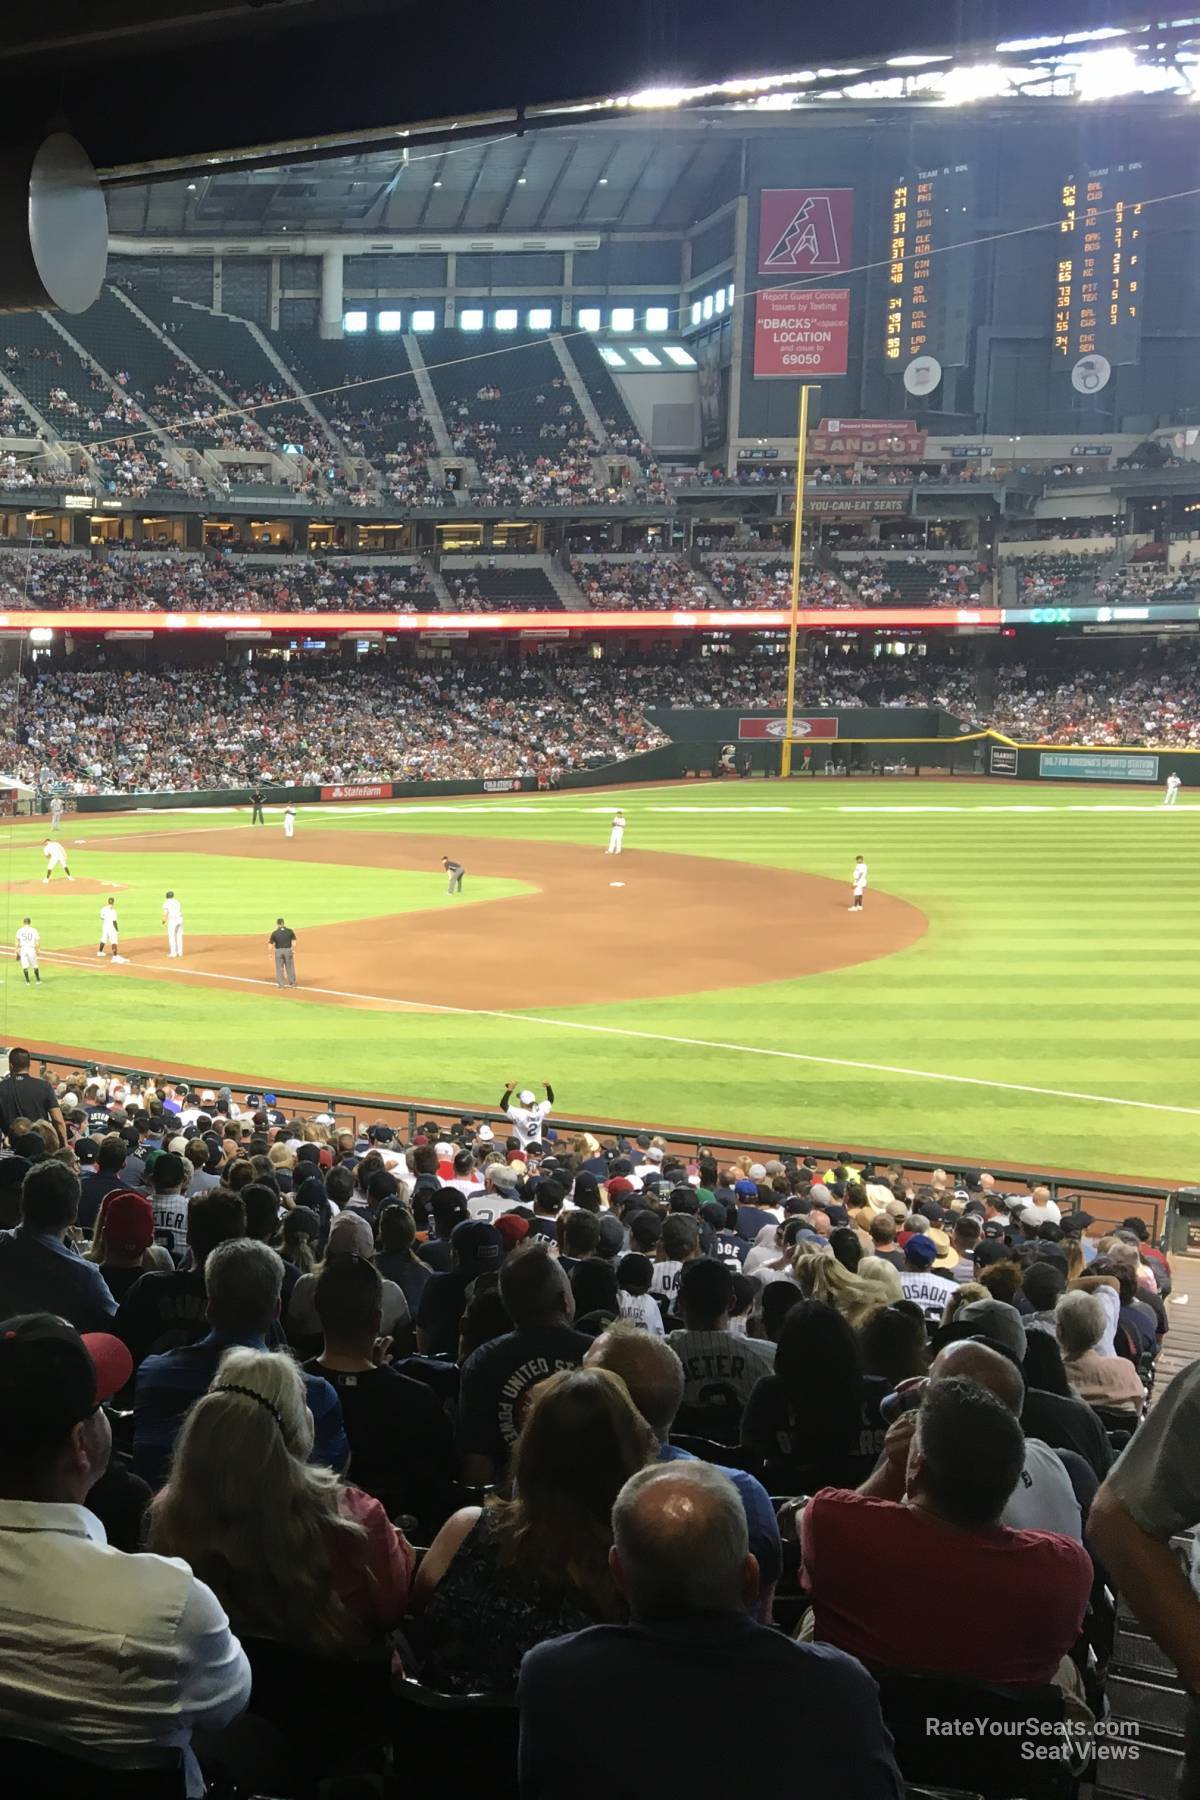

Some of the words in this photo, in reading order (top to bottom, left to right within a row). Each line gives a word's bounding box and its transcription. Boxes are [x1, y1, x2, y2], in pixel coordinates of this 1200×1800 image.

[918, 170, 938, 179] TEAM
[1088, 168, 1108, 177] TEAM
[1063, 185, 1076, 196] 54
[894, 198, 906, 208] 27
[893, 223, 905, 233] 31
[1061, 221, 1074, 232] 57
[916, 234, 931, 244] CLE
[892, 248, 904, 258] 31
[891, 263, 903, 273] 28
[891, 274, 903, 283] 48
[763, 292, 788, 301] Report
[790, 292, 812, 300] Guest
[815, 291, 847, 300] Conduct
[1059, 287, 1071, 296] 73
[913, 295, 927, 304] ATL
[772, 303, 796, 311] Issues
[798, 303, 807, 312] by
[810, 302, 837, 312] Texting
[1057, 312, 1069, 321] 41
[888, 323, 901, 333] 57
[1056, 322, 1069, 332] 55
[773, 332, 831, 343] LOCATION
[911, 336, 926, 344] LAD
[1056, 336, 1068, 346] 34
[910, 346, 920, 354] SF
[782, 354, 821, 365] 69050
[814, 437, 921, 453] SANDLOT
[874, 500, 904, 511] SEATS
[1029, 608, 1071, 624] COX
[527, 1123, 538, 1137] 2
[153, 1211, 185, 1229] ETER
[536, 1233, 558, 1249] TER
[716, 1242, 740, 1257] DGE
[902, 1284, 948, 1304] OSADA
[502, 1357, 549, 1399] UNITED
